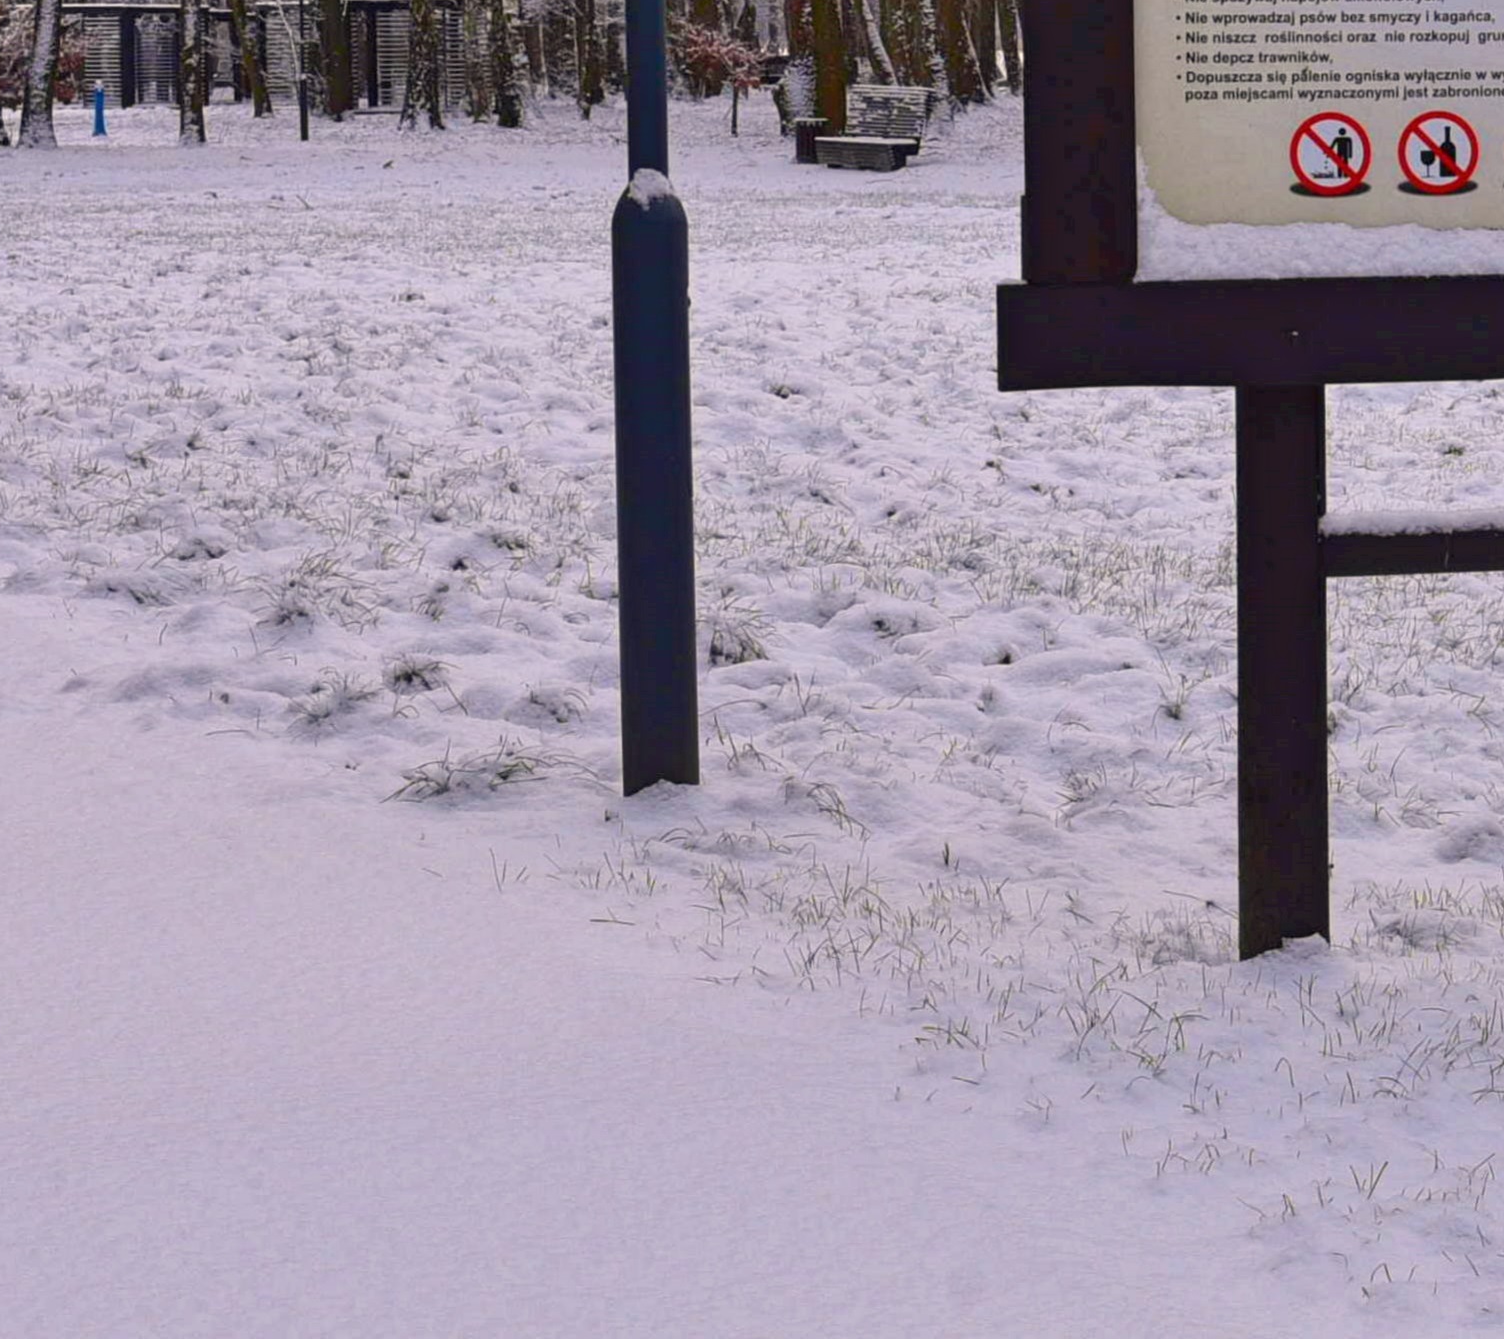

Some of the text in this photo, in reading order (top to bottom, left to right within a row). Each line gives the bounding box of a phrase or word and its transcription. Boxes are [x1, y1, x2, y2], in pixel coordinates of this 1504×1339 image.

[1185, 10, 1208, 23] Nie
[1212, 10, 1296, 27] wprowadzaj
[1299, 10, 1337, 27] psów
[1341, 10, 1365, 23] bez
[1369, 12, 1421, 26] smyczy
[1433, 9, 1495, 26] kagańca,
[1185, 31, 1208, 44] Nie
[1212, 30, 1257, 43] niszcz
[1264, 30, 1342, 43] roślinności
[1347, 33, 1377, 43] oraz
[1384, 30, 1405, 43] nie
[1409, 29, 1470, 46] rozkopuj
[1186, 50, 1333, 68] Nie depcz trawników,
[1186, 70, 1263, 87] Dopuszcza
[1266, 69, 1287, 86] się
[1345, 68, 1400, 85] ogniska
[1404, 67, 1471, 84] wyłącznie
[1476, 70, 1489, 80] w
[1185, 90, 1218, 104] poza
[1222, 86, 1293, 103] miejscami
[1297, 86, 1399, 103] wyznaczonymi
[1403, 85, 1428, 102] jest
